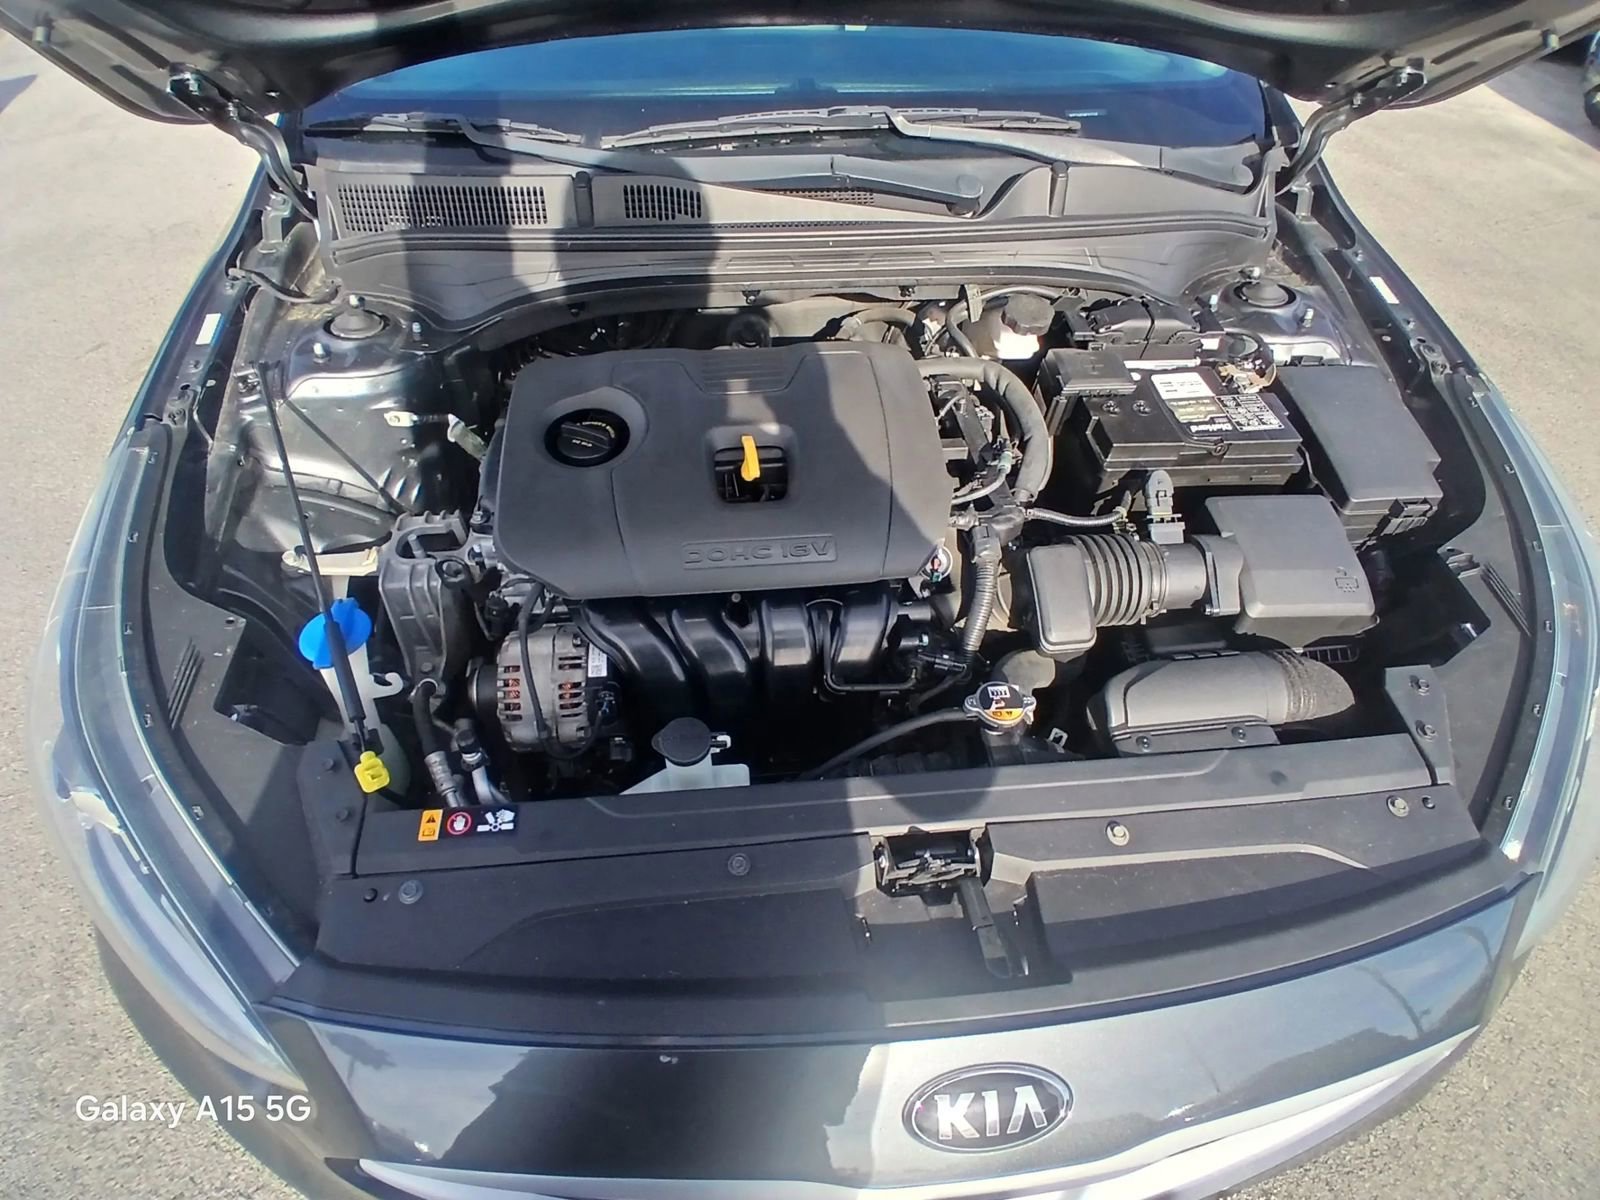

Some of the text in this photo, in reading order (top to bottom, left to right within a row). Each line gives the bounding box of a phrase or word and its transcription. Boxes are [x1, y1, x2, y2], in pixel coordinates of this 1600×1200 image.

[1190, 423, 1232, 432] DieHard
[685, 540, 829, 564] DOHC 16V
[934, 1085, 1048, 1140] KIA
